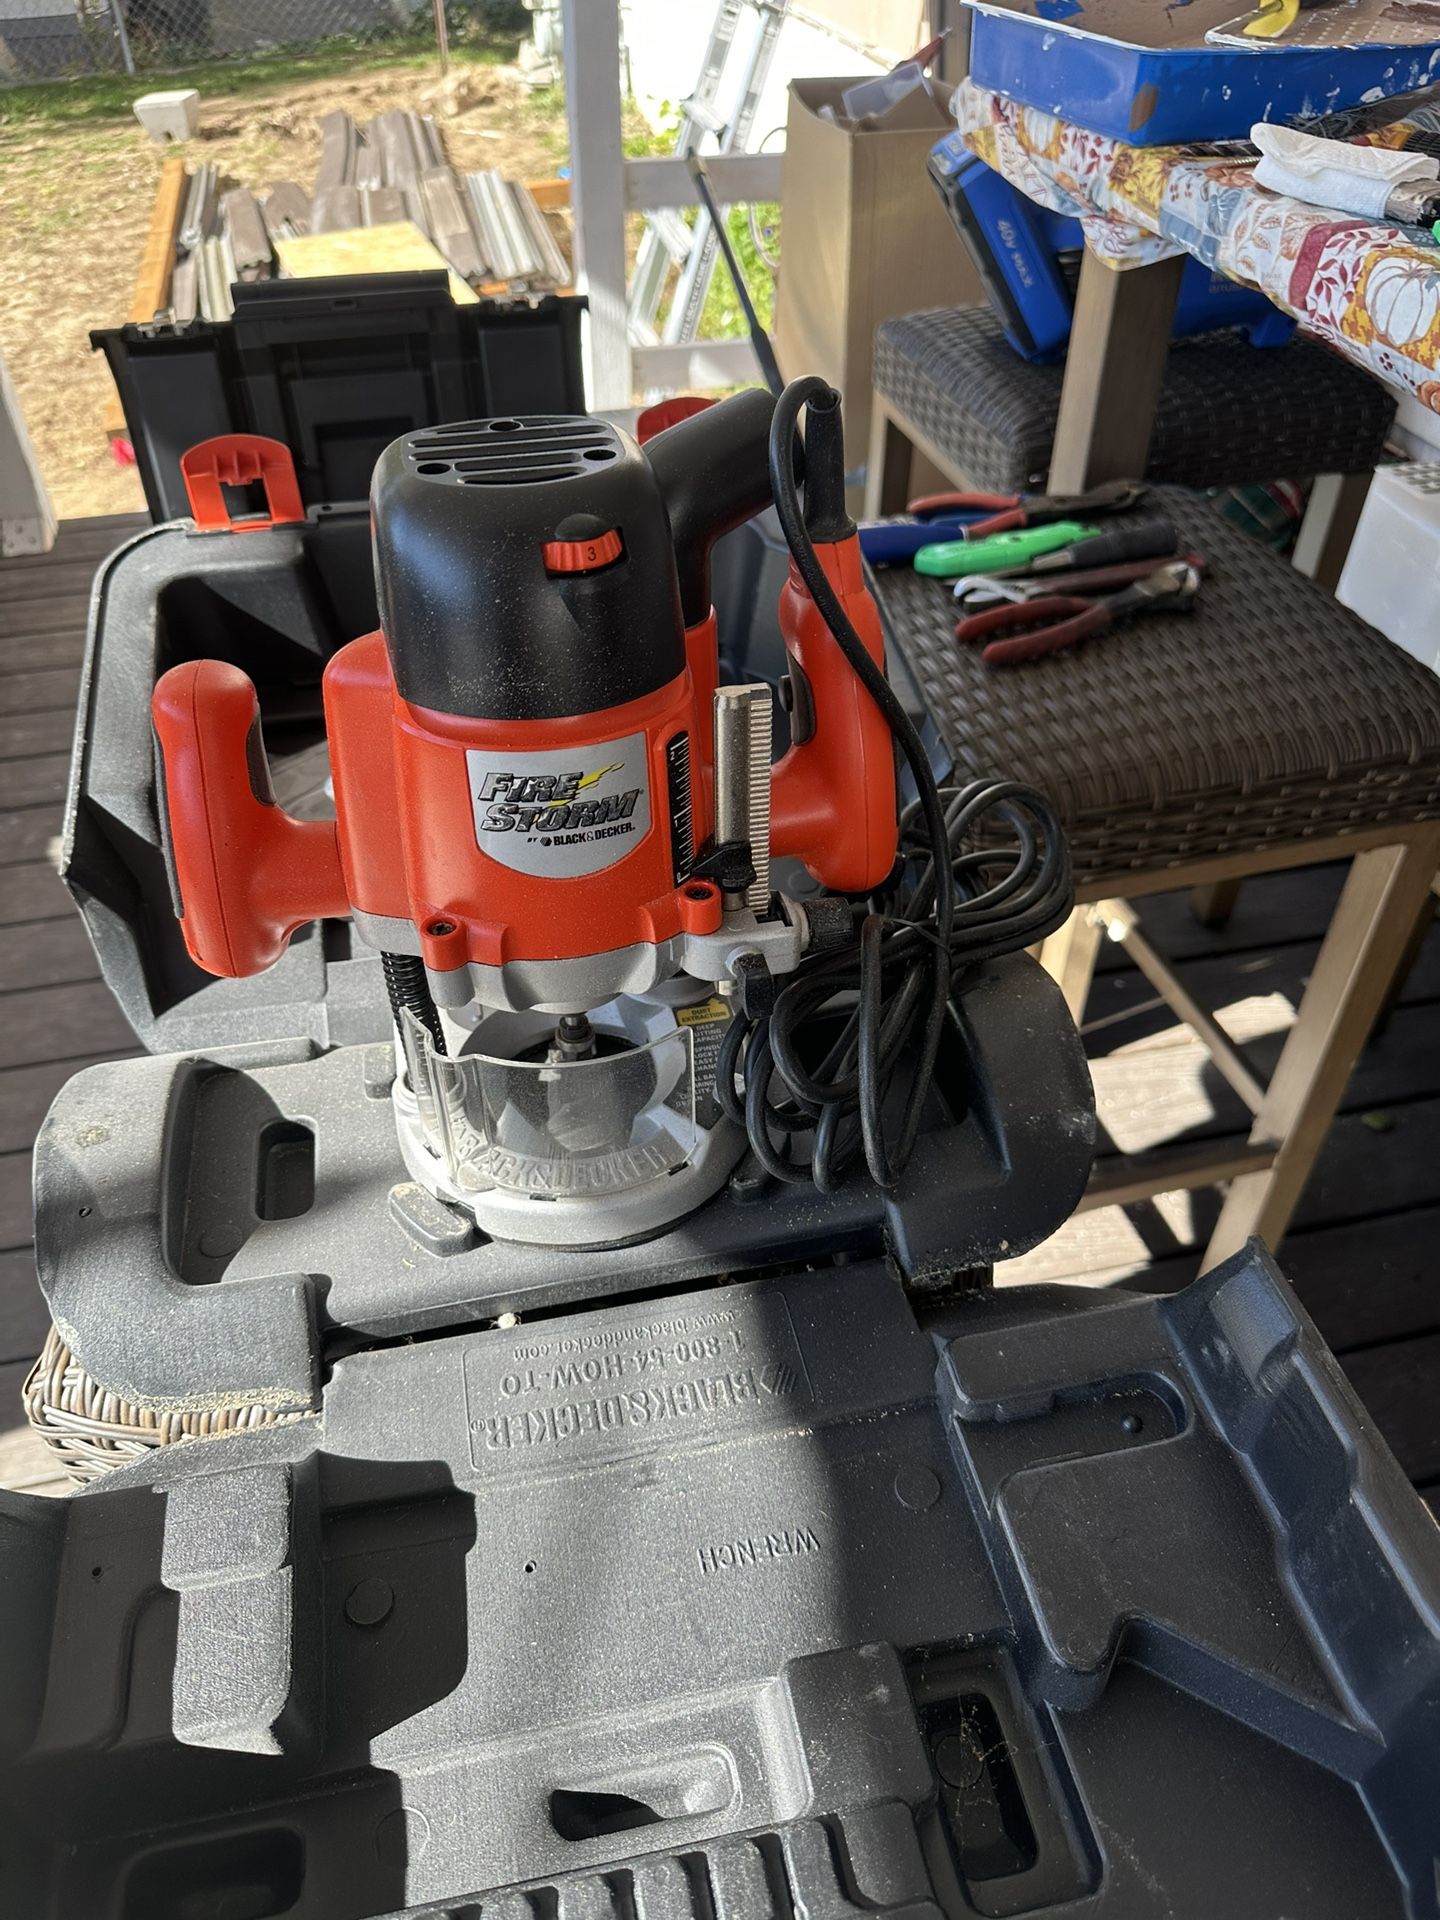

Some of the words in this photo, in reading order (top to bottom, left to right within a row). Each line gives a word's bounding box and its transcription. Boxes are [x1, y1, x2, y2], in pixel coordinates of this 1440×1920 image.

[587, 546, 597, 562] 3
[670, 751, 676, 761] 2
[478, 771, 584, 803] FIRE
[481, 788, 641, 833] STORM
[554, 822, 633, 847] BLACK&DECKER
[692, 1028, 722, 1038] UTTING
[512, 1309, 735, 1363] www.blackanddecker.com
[499, 1330, 745, 1398] 1-800-54-HOW-TO
[696, 1525, 820, 1575] WRENCH
